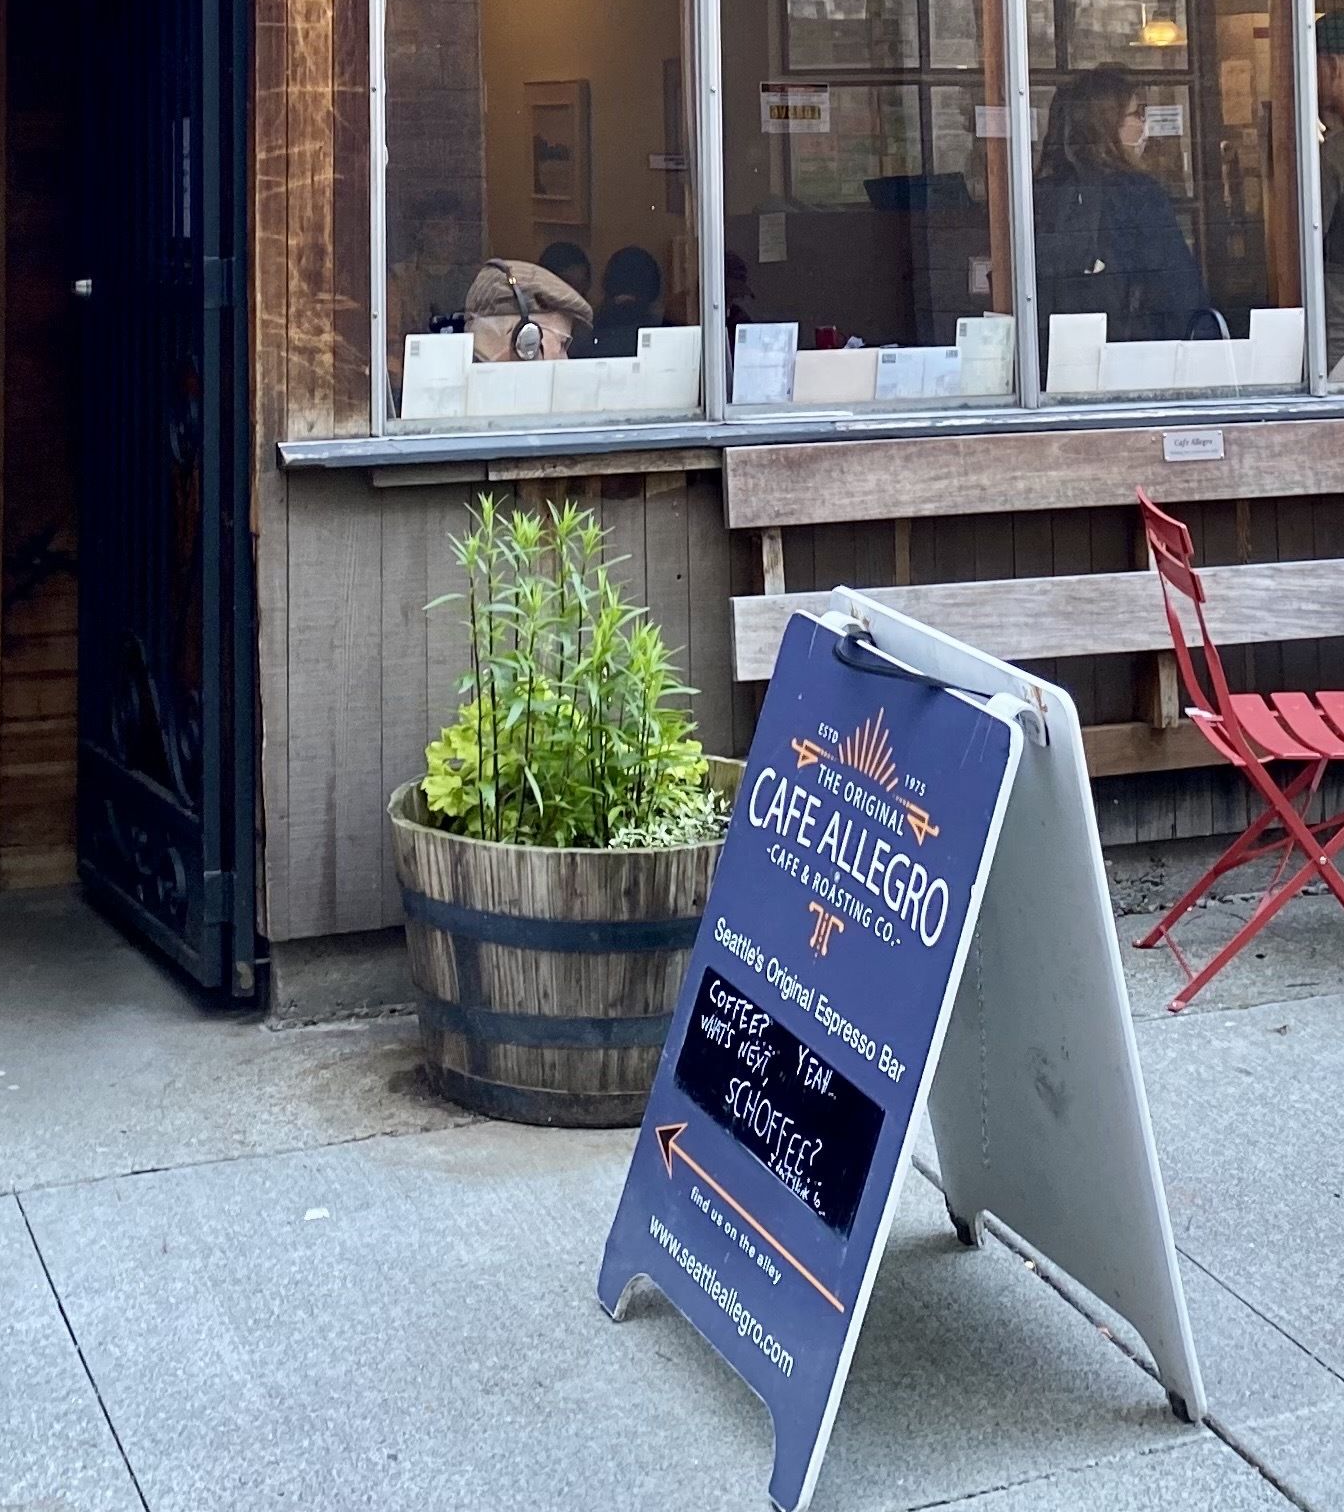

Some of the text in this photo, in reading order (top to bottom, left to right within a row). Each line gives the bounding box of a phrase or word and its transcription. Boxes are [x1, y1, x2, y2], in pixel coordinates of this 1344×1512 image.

[817, 763, 905, 837] THE ORIGINAL
[818, 722, 927, 797] ESTD 1975
[748, 767, 950, 948] CAFE ALLEGRO
[800, 864, 810, 886] &
[811, 872, 874, 928] ROASTING
[701, 1013, 736, 1049] WHAT'S
[709, 979, 771, 1038] COFFEE?
[714, 917, 907, 1083] Seattle's Original Espresso Bar
[725, 1077, 823, 1176] SCHOFFEE?
[690, 1185, 782, 1285] find us on the alley
[649, 1215, 794, 1378] www.seattleallegro.com
